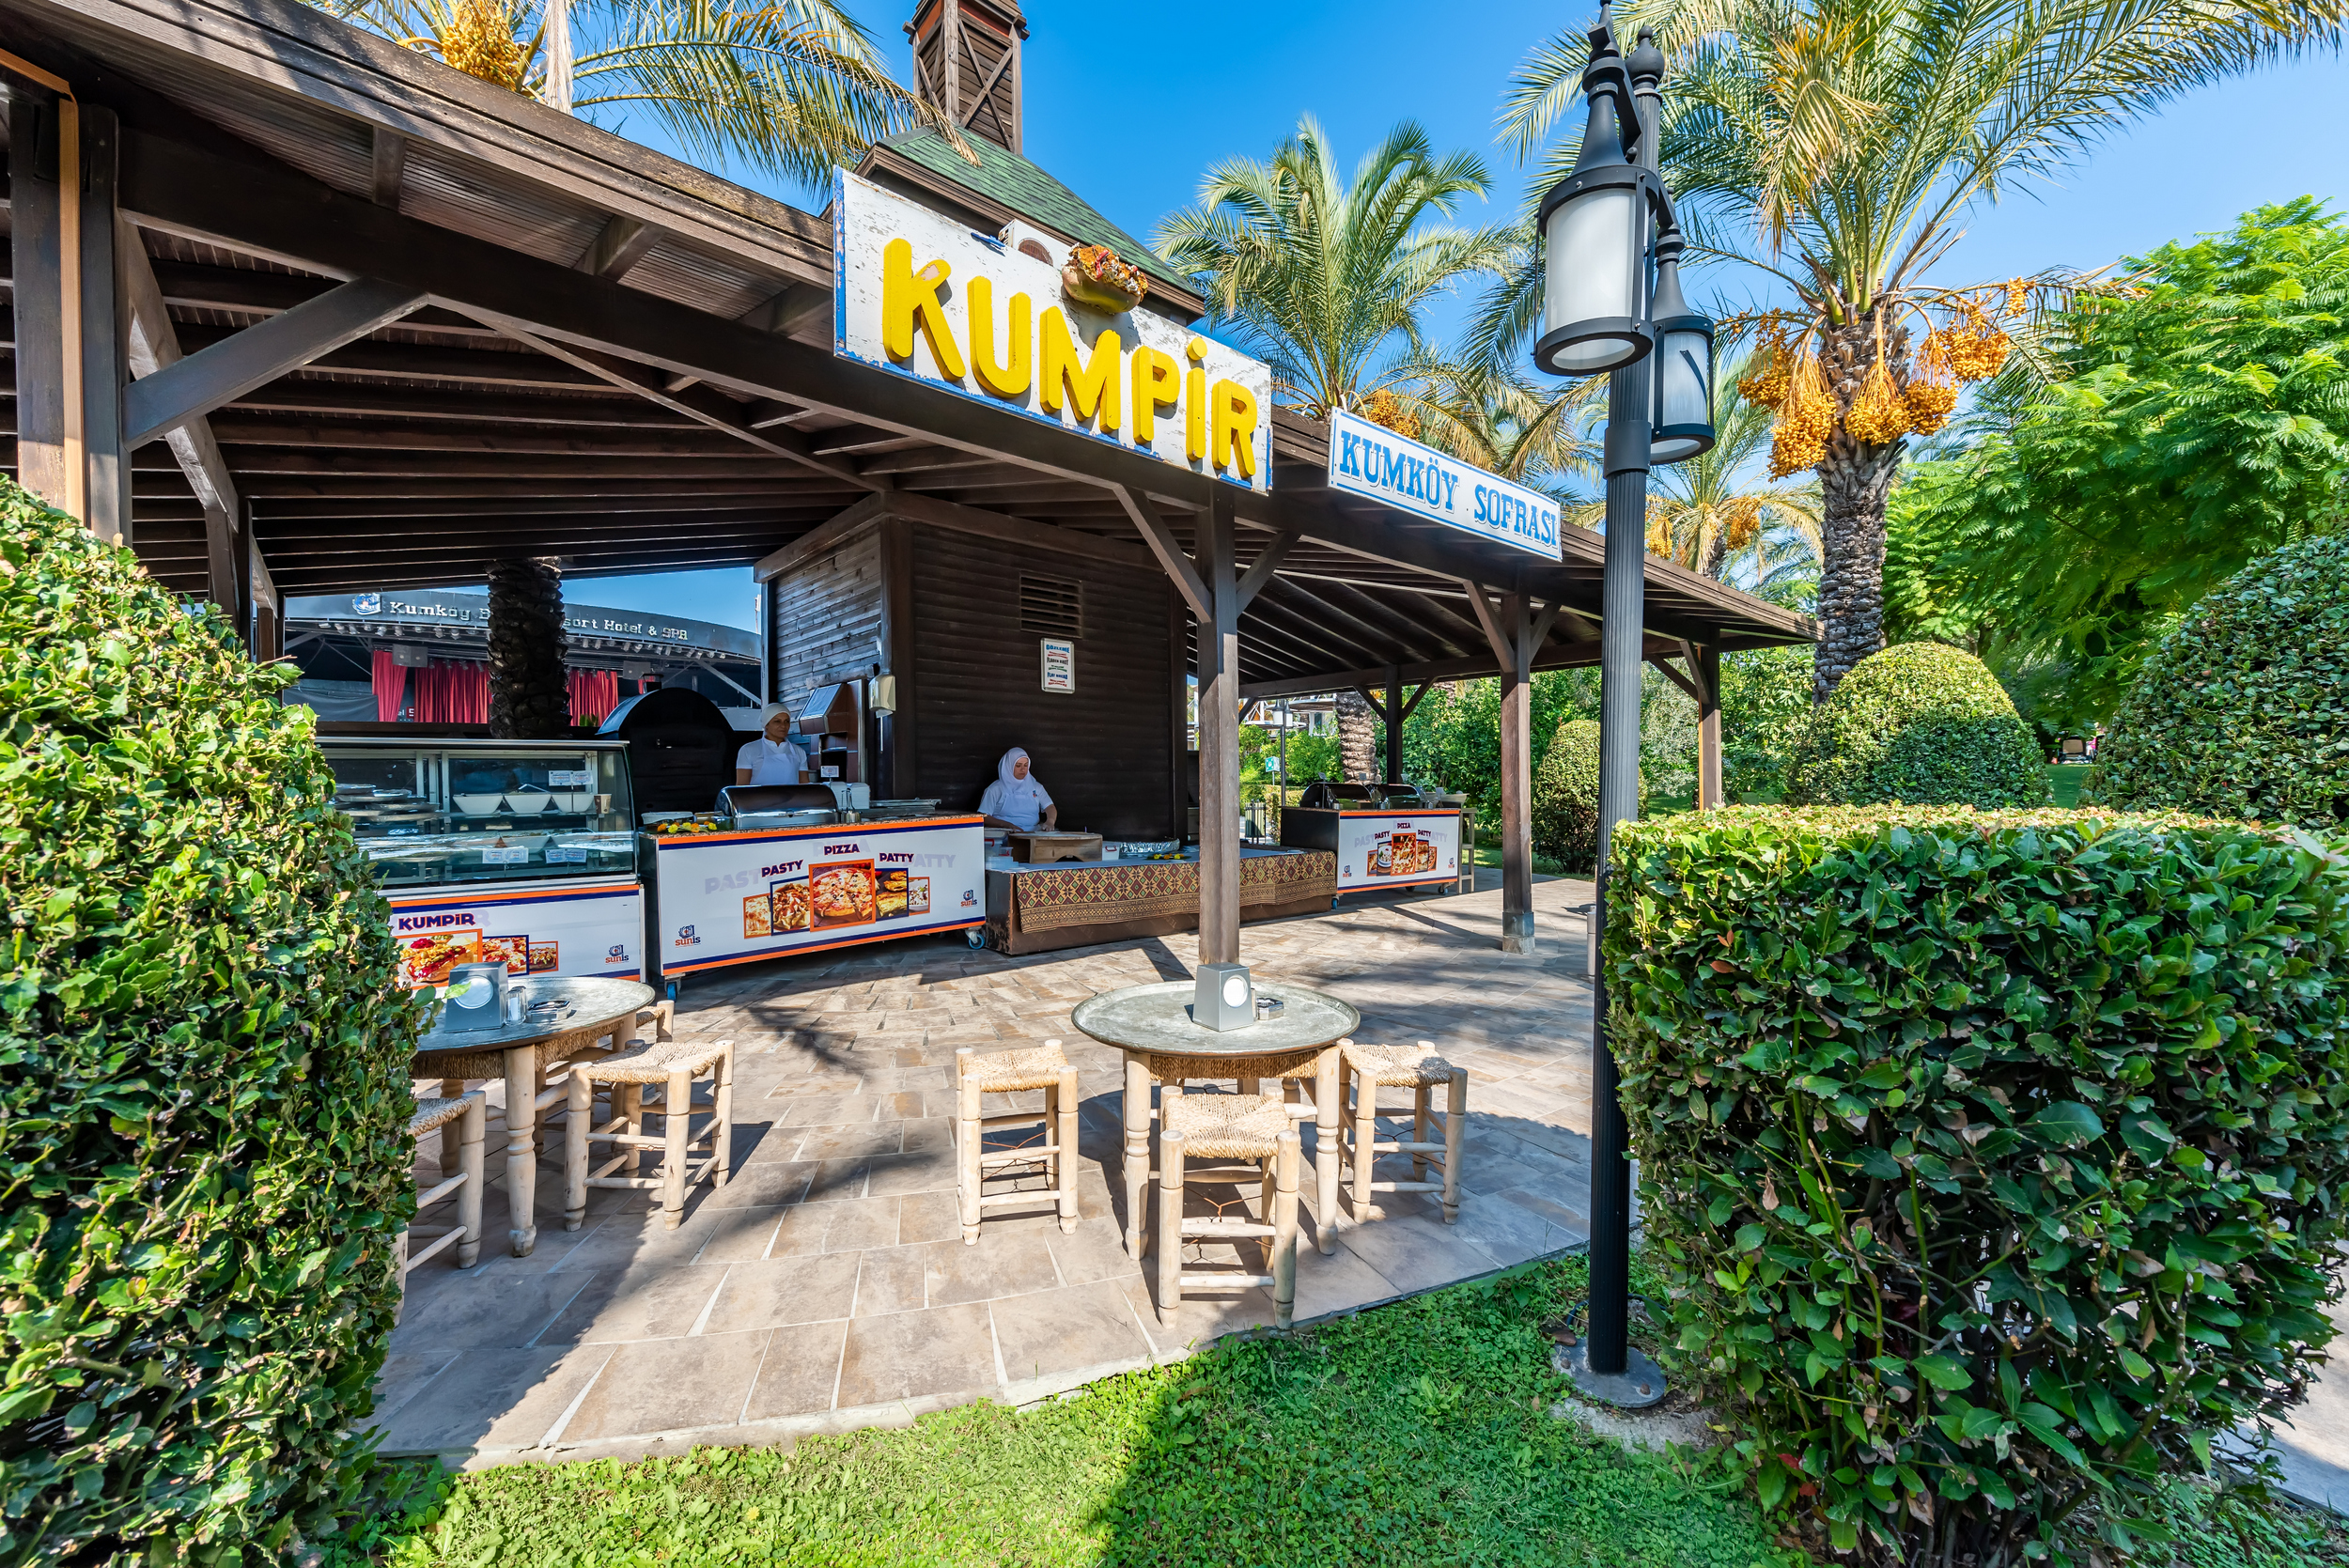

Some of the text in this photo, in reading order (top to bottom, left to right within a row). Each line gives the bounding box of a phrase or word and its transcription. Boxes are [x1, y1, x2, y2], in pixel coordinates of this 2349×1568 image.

[1339, 429, 1559, 548] KUMKÖY SOFRASI
[389, 601, 471, 621] Kumköy
[563, 617, 598, 629] sort
[603, 619, 643, 634] Hotel
[647, 625, 658, 636] &
[661, 627, 689, 641] SPA
[1375, 831, 1390, 839] PASTY
[823, 843, 861, 856] PIZZA
[879, 852, 914, 862] PATTY
[761, 859, 803, 877] PASTY
[705, 868, 772, 894] PAST
[675, 935, 701, 946] sunis
[605, 954, 630, 963] sunis
